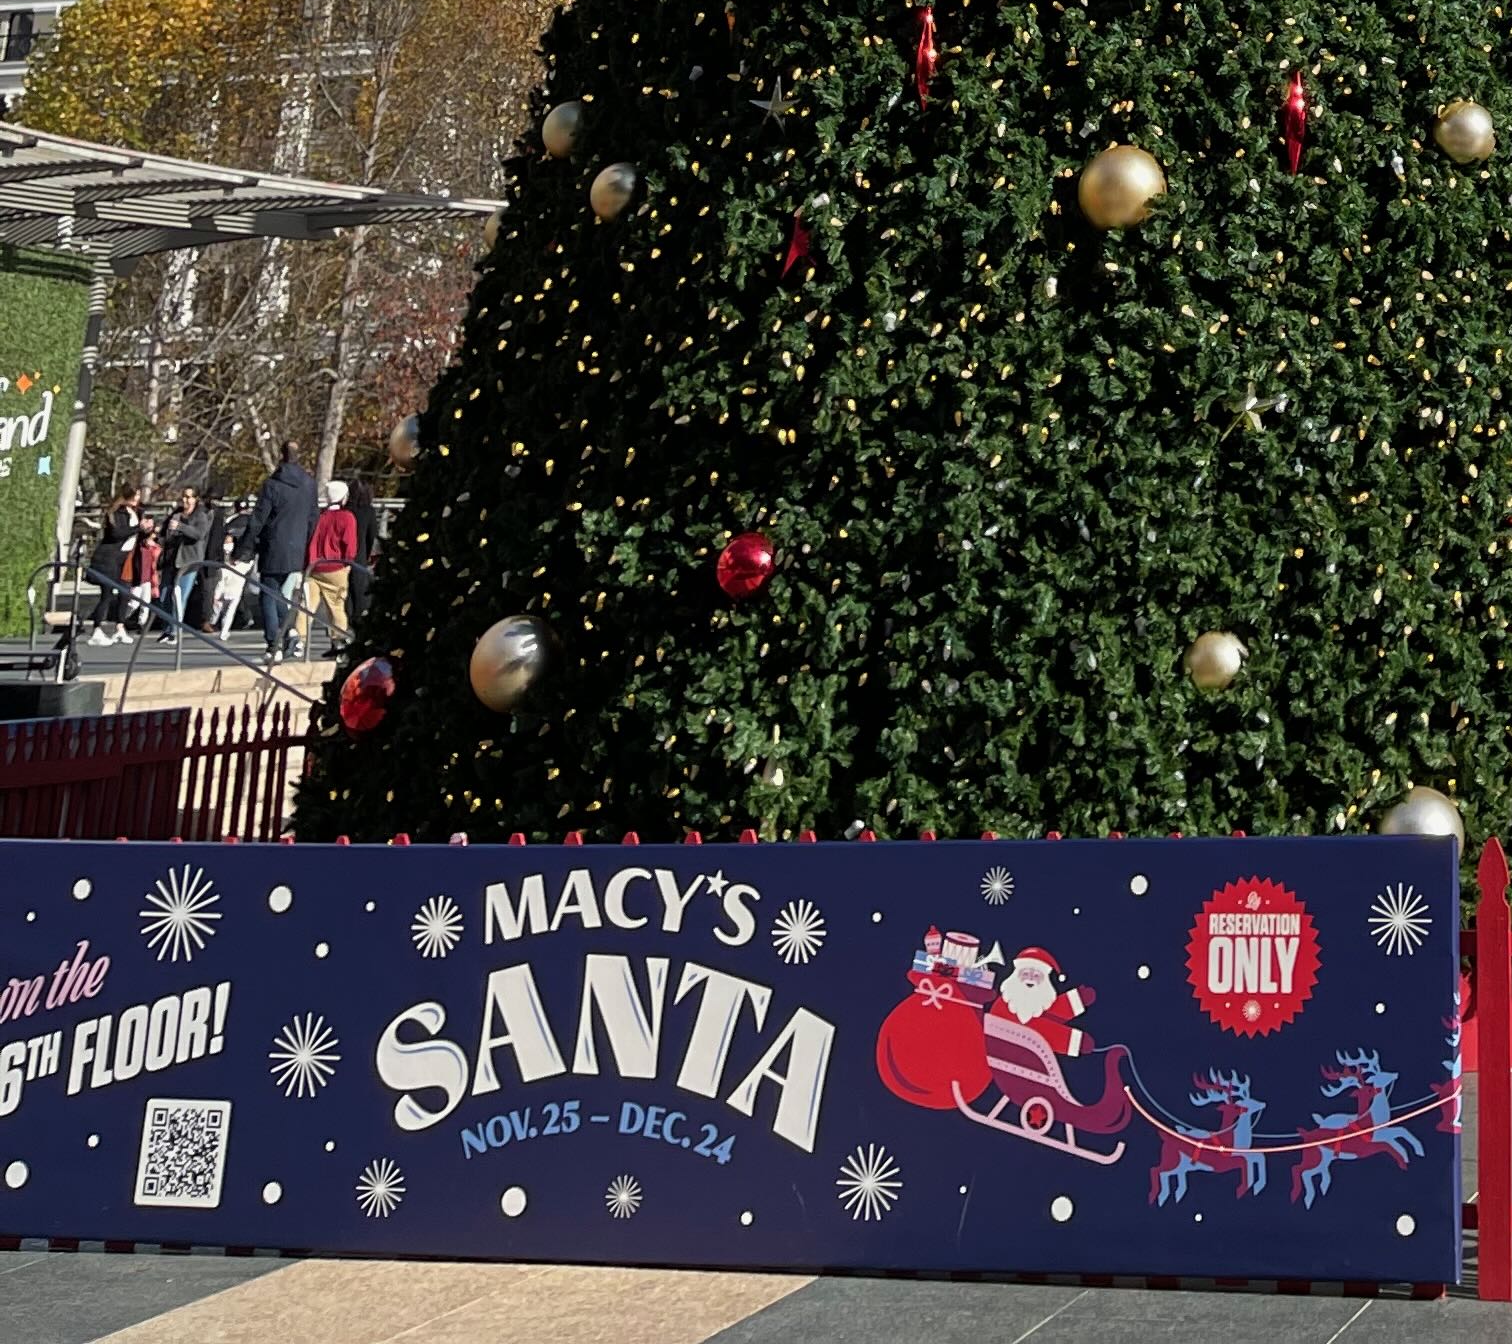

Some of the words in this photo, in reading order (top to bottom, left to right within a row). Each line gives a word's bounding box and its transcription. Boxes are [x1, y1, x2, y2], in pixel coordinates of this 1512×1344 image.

[1208, 913, 1301, 936] RESERVATION
[0, 975, 45, 1024] on
[45, 940, 110, 1010] the
[1207, 937, 1300, 994] ONLY
[0, 1030, 62, 1117] 6TH
[67, 981, 231, 1096] FLOOR!
[376, 953, 836, 1154] SANTA
[460, 1106, 537, 1159] NOV.
[541, 1100, 581, 1135] 25
[618, 1101, 691, 1149] DEC.
[693, 1124, 737, 1165] 24
